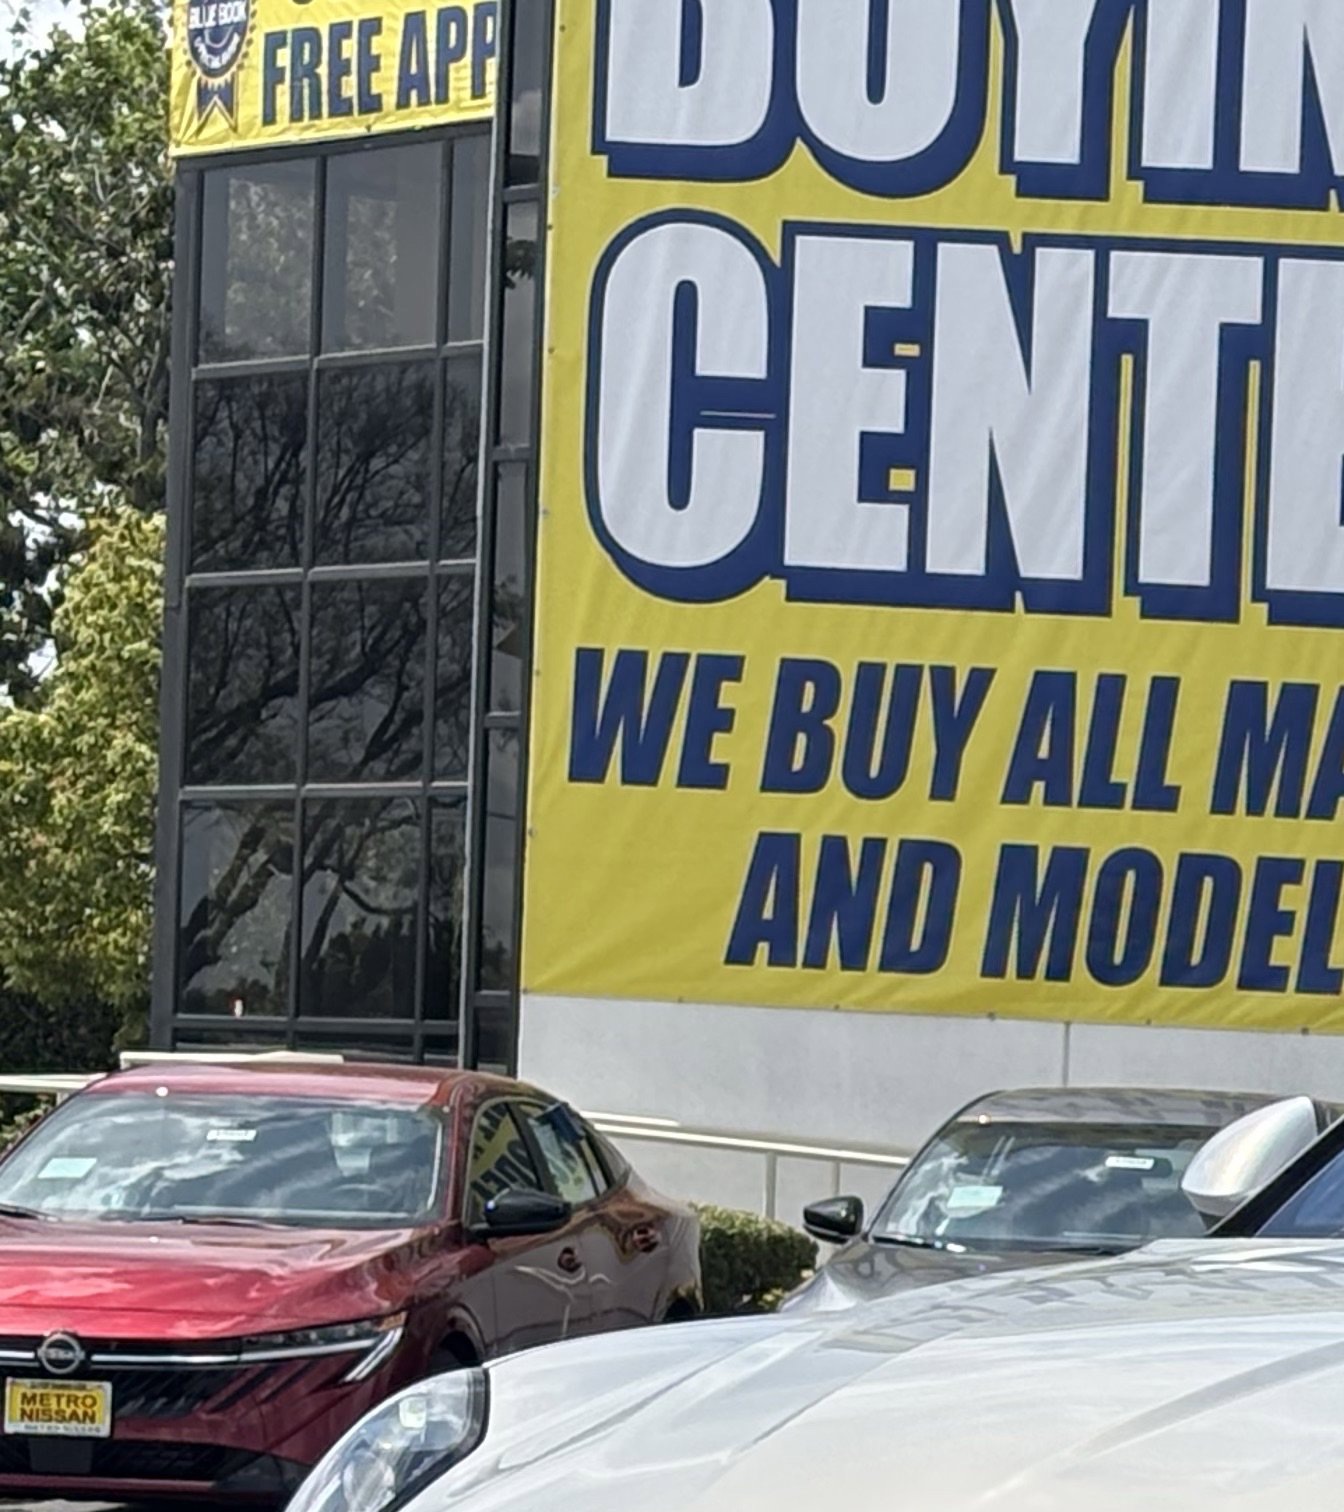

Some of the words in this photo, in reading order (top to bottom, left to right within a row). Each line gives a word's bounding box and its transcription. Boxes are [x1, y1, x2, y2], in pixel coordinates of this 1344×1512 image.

[262, 16, 384, 127] FREE
[566, 647, 747, 790] WE
[759, 657, 997, 801] BUY
[999, 668, 1181, 814] ALL
[722, 830, 964, 973] AND
[20, 1391, 98, 1409] METRO
[20, 1407, 97, 1424] NISSAN
